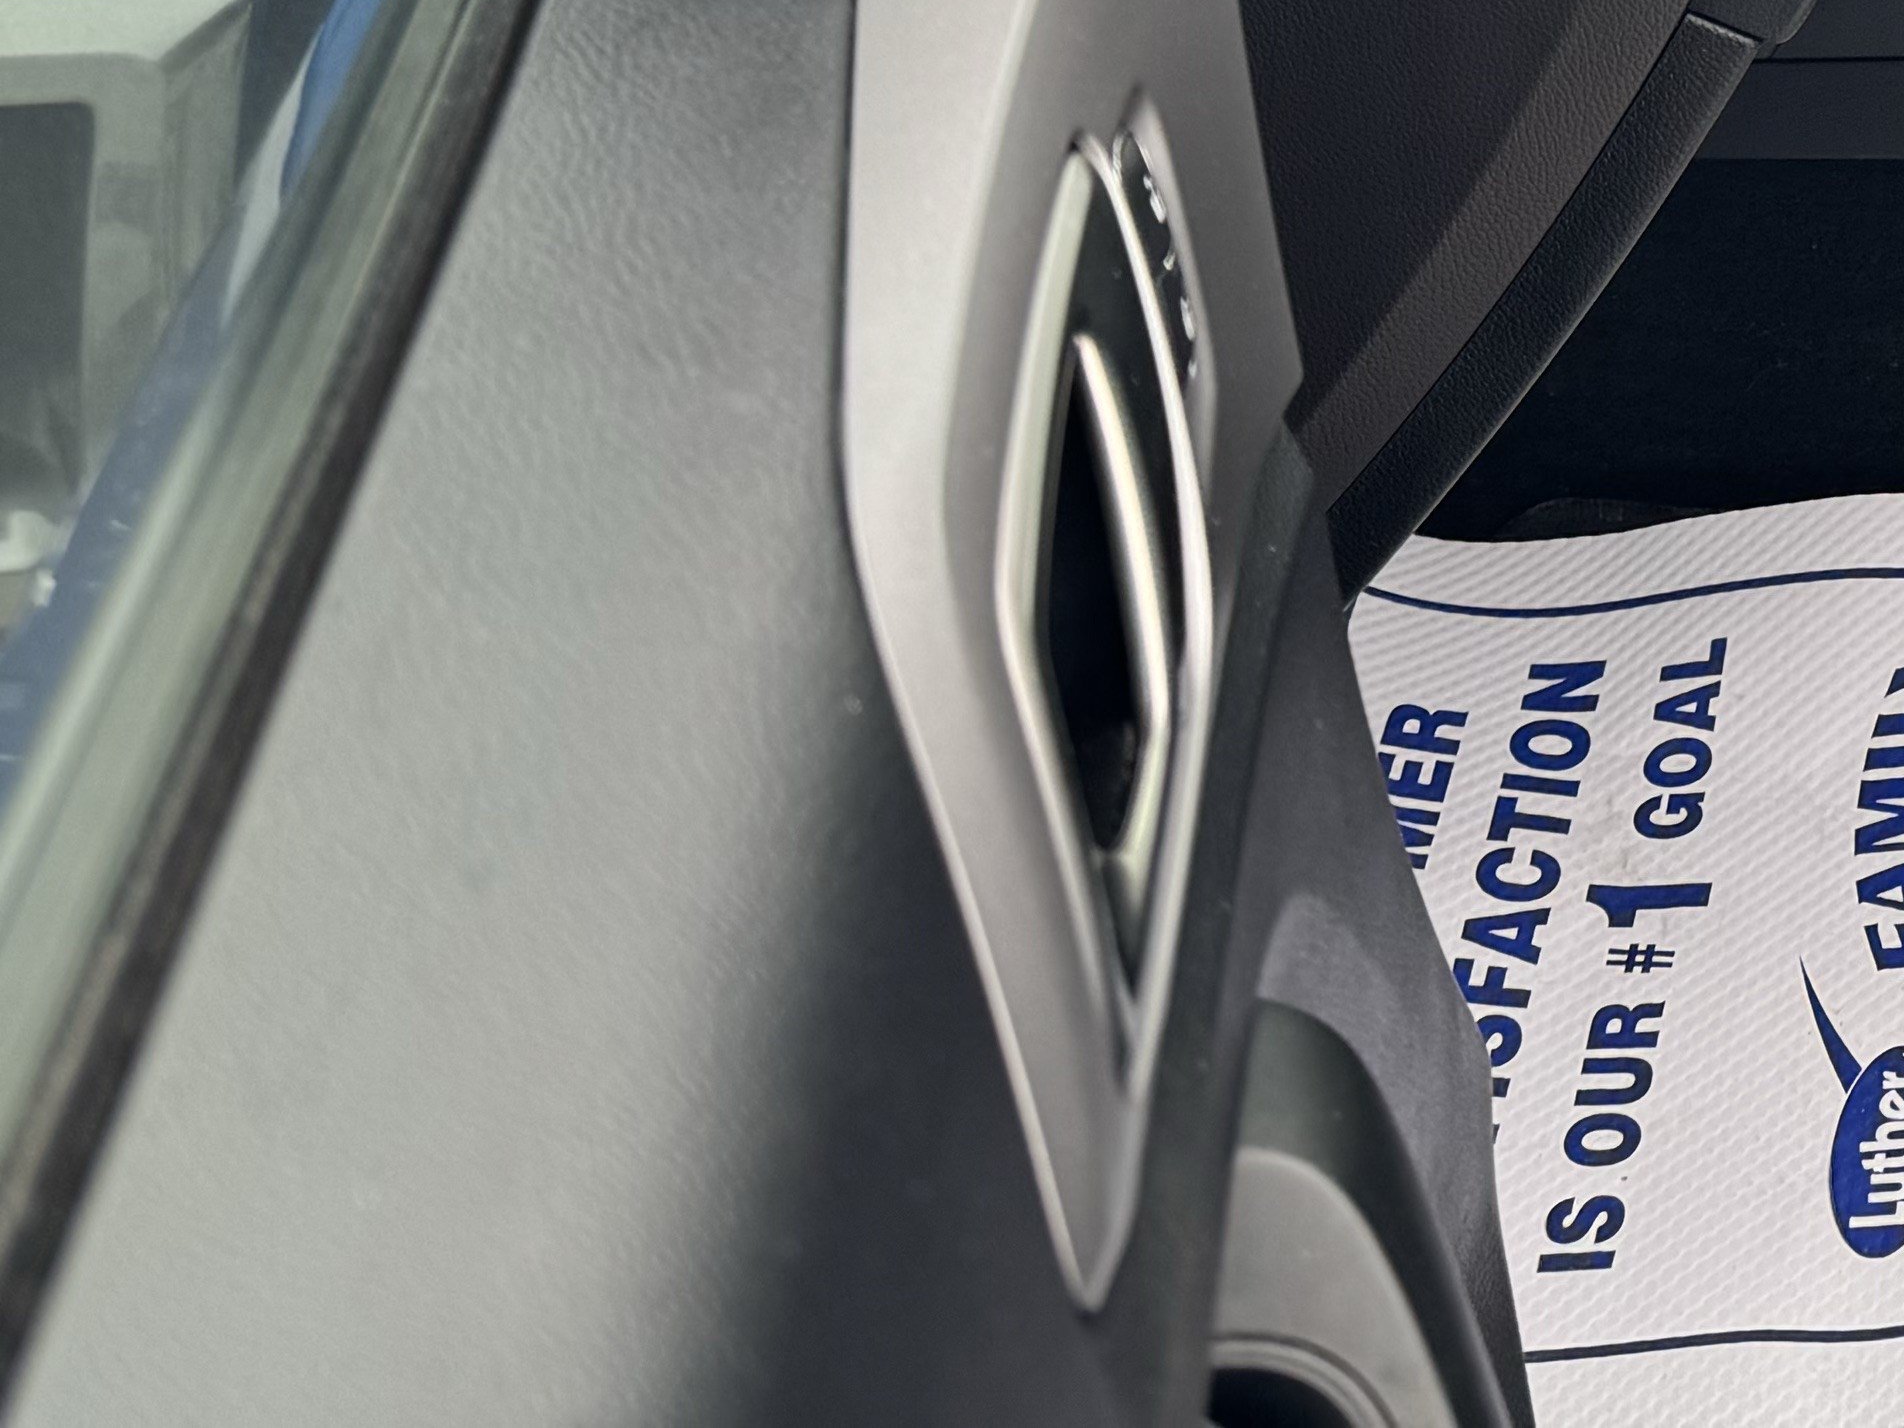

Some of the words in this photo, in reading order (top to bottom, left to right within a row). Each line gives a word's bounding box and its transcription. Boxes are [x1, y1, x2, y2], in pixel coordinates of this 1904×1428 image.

[1632, 637, 1728, 839] GOAL
[1563, 1000, 1667, 1167] OUR
[1536, 1195, 1627, 1274] IS
